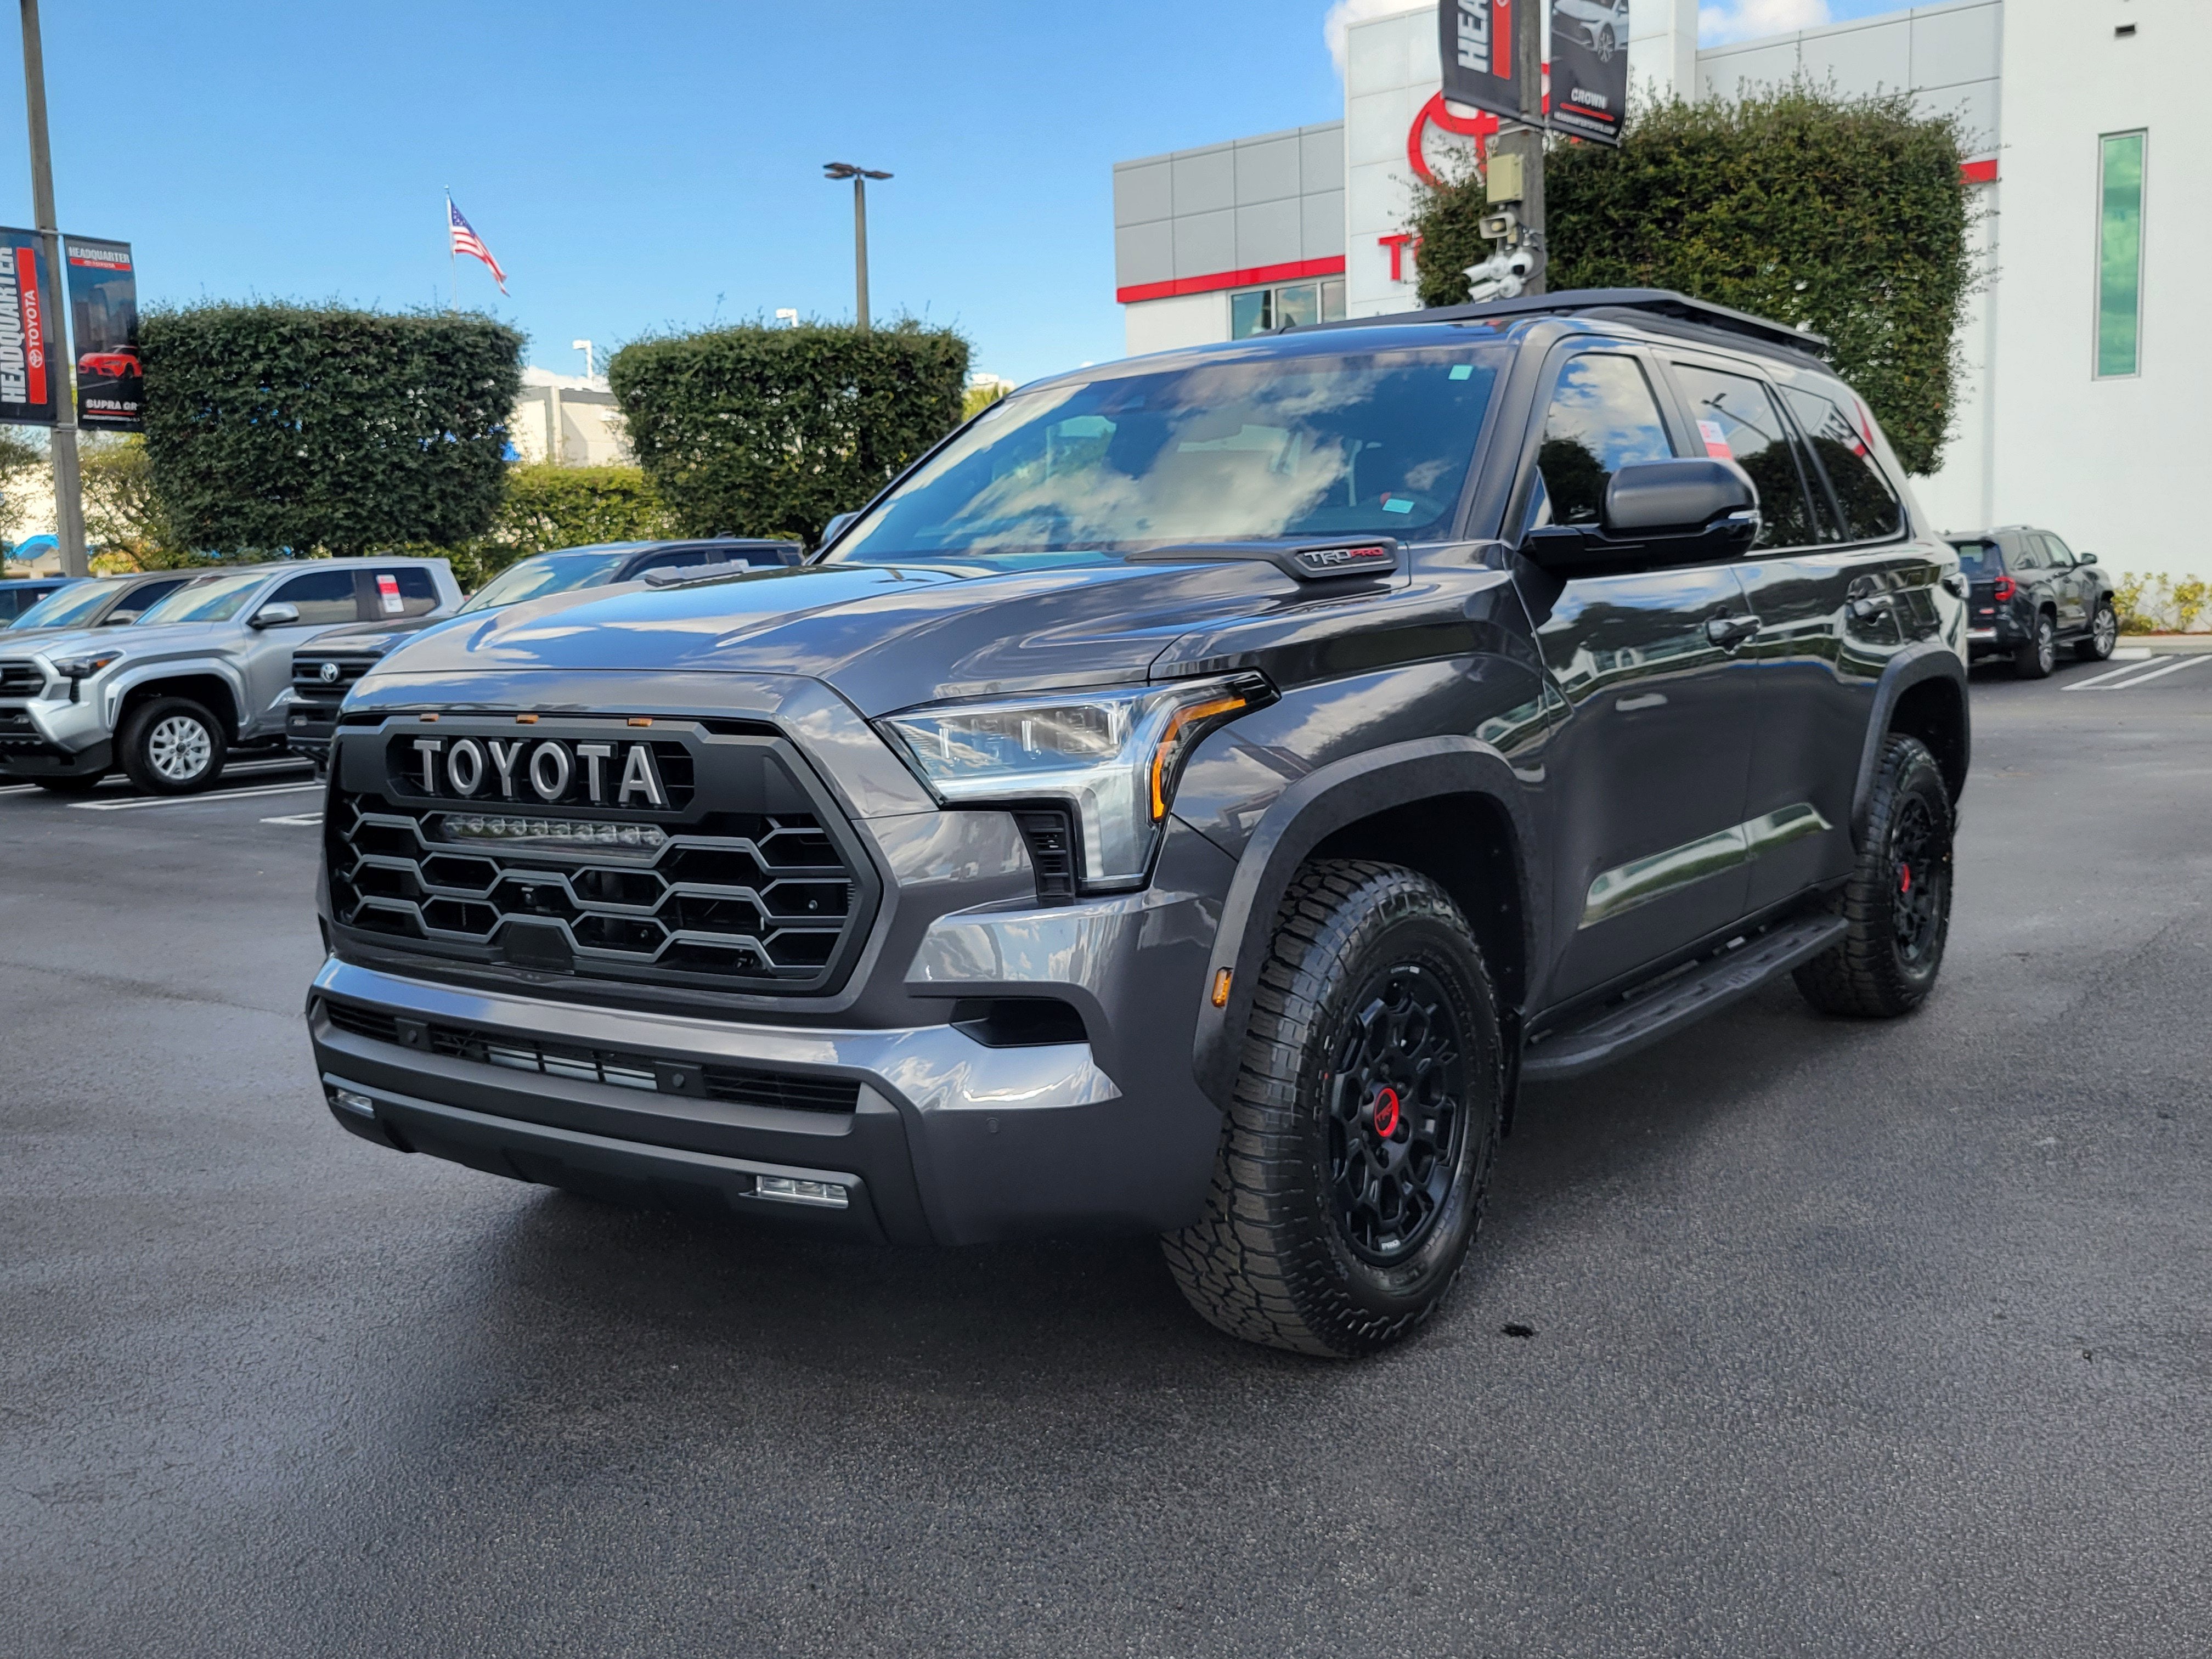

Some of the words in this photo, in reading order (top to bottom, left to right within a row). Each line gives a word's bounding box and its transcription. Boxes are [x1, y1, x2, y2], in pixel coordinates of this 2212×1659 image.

[1571, 87, 1608, 109] CROWN
[69, 246, 130, 263] HEADQUARTER
[25, 290, 40, 347] TOYOTA
[86, 398, 122, 410] SUPRA
[122, 401, 138, 410] GR
[1350, 546, 1384, 557] PRO
[413, 738, 664, 806] TOYOTA
